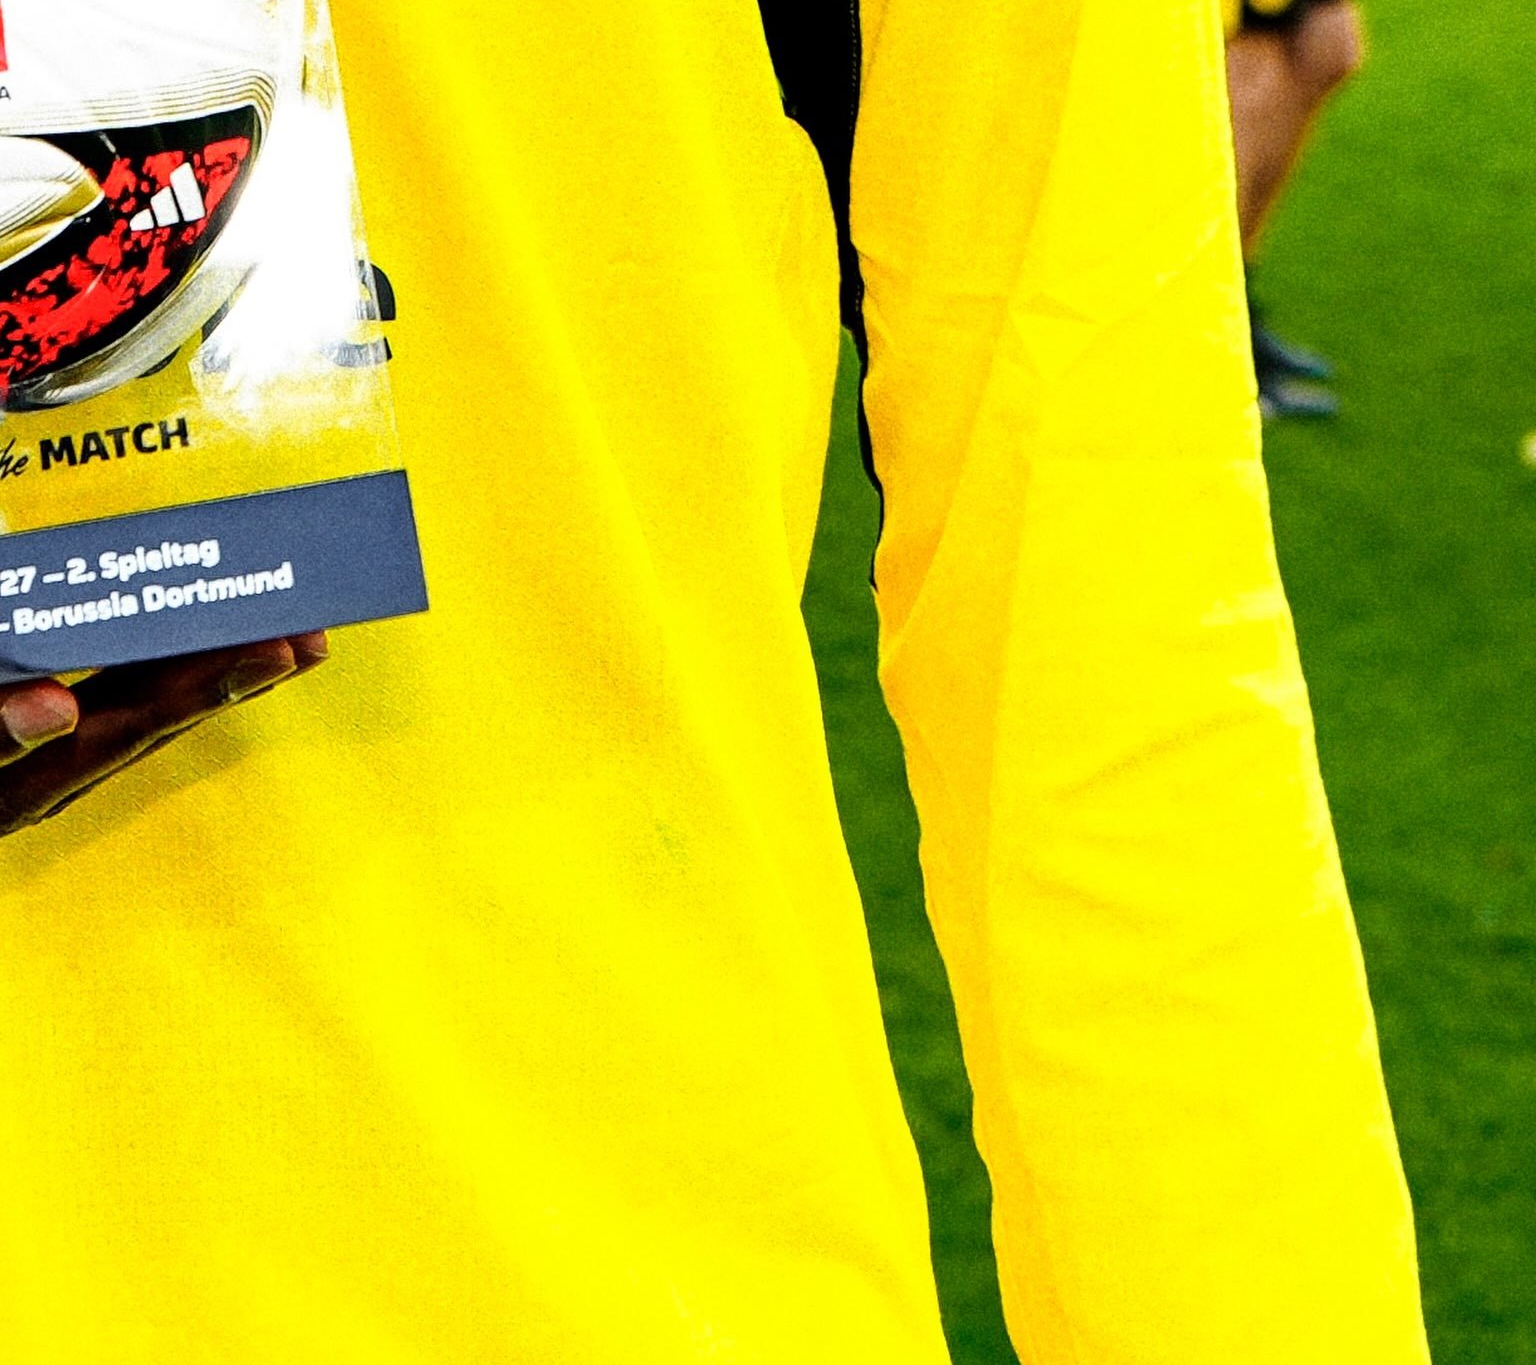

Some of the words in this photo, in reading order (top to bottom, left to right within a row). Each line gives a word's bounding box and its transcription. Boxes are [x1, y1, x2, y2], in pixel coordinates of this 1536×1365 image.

[39, 417, 189, 470] MATCH
[65, 557, 96, 585] 2.
[98, 539, 221, 582] Spieltag
[13, 591, 139, 635] Borussia
[142, 561, 295, 613] Dortmund
